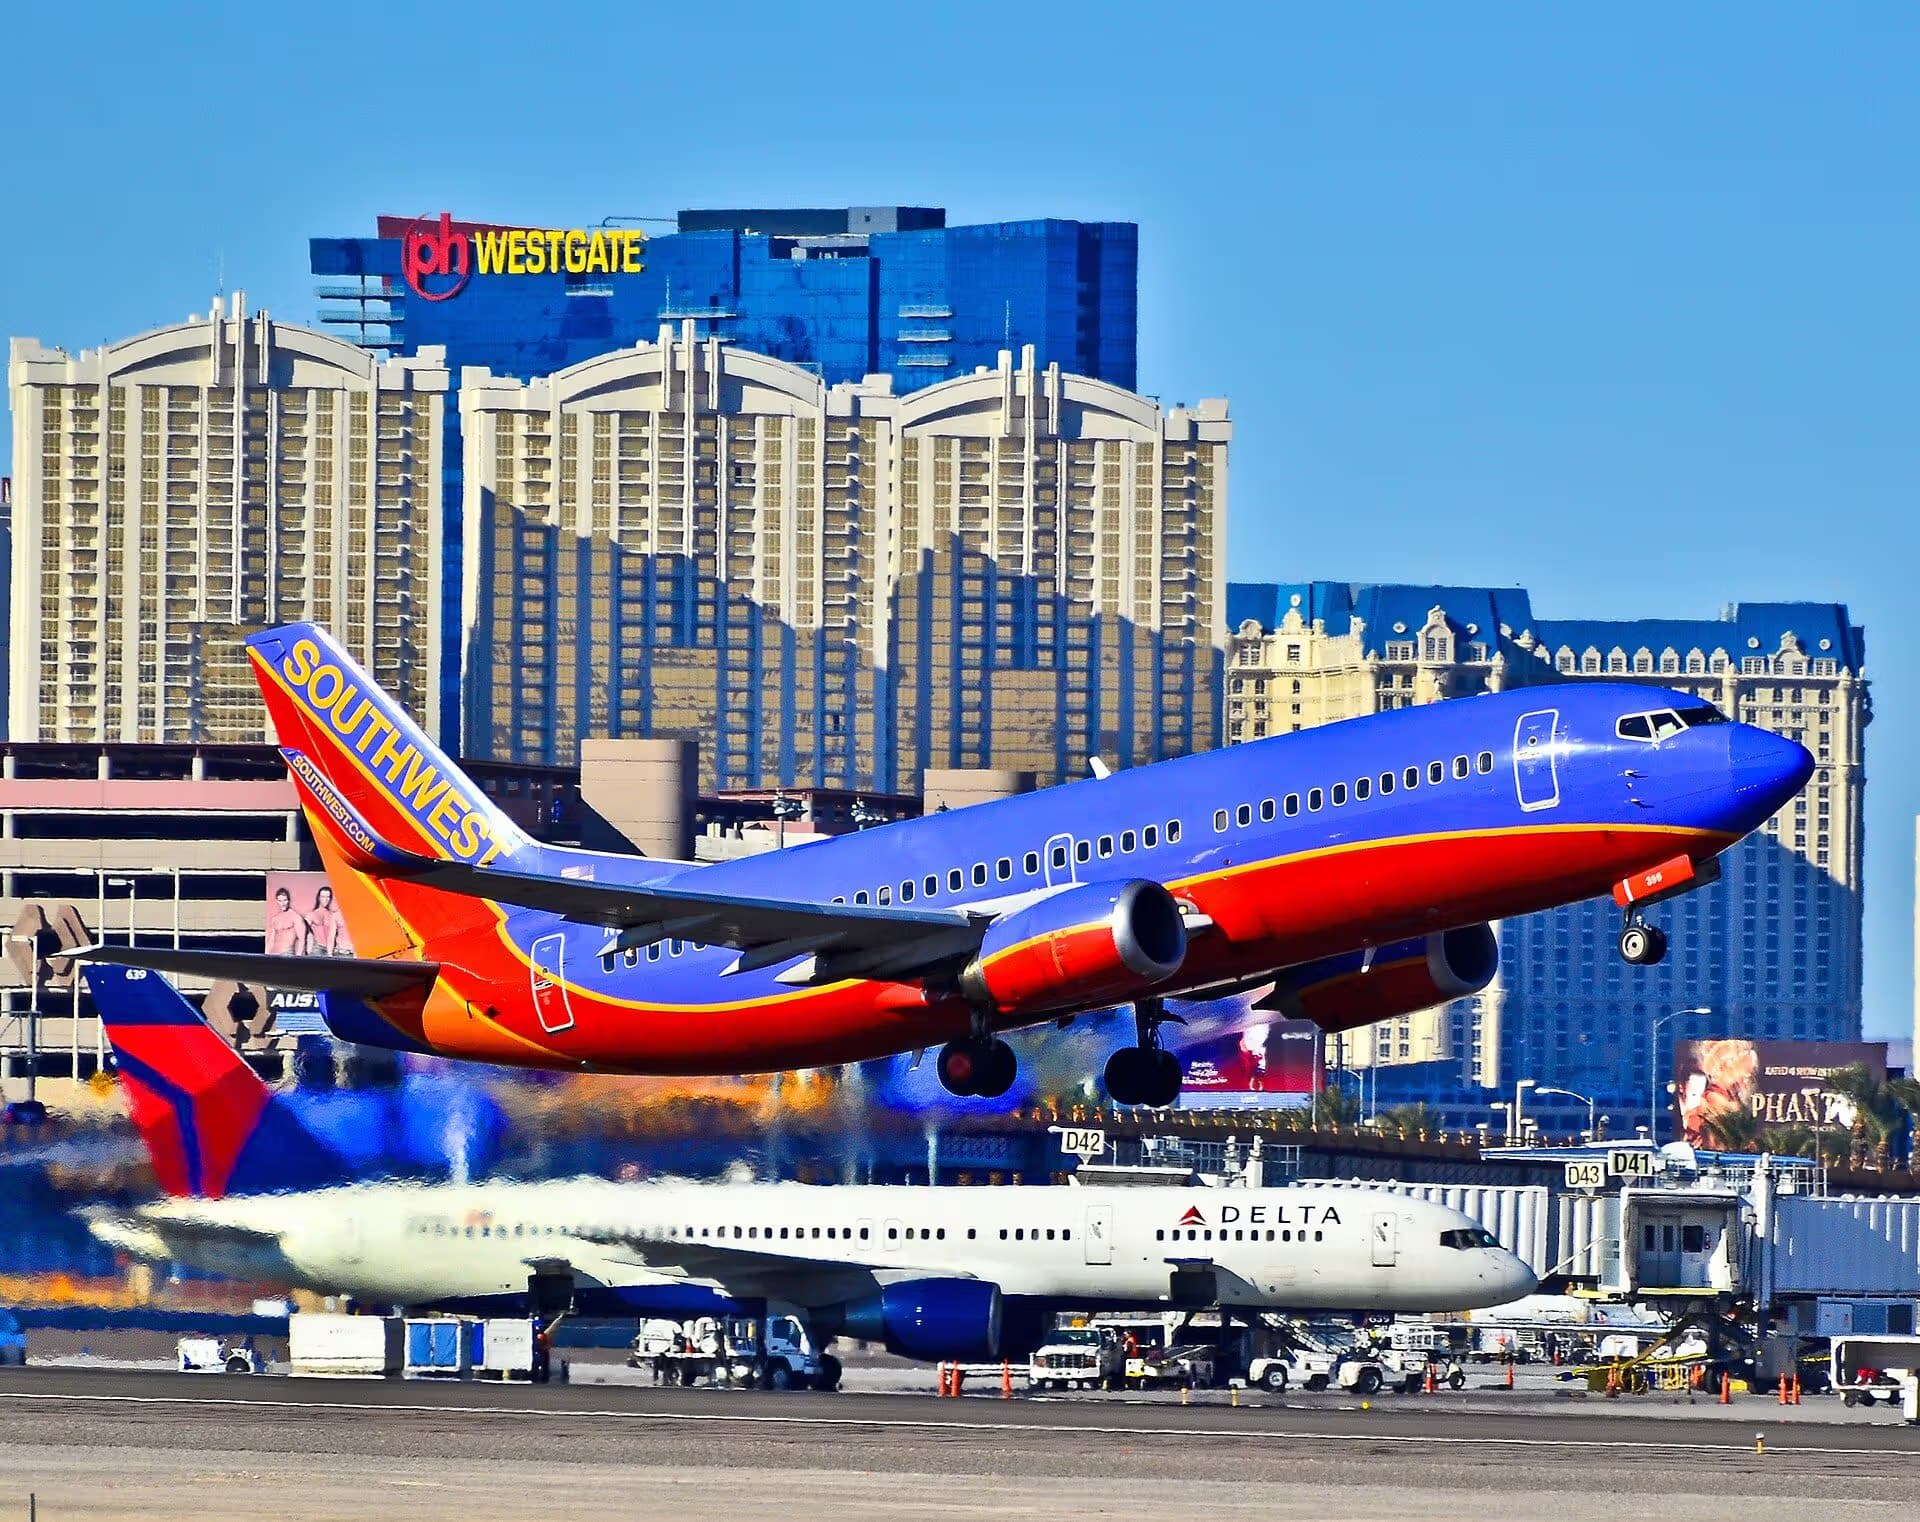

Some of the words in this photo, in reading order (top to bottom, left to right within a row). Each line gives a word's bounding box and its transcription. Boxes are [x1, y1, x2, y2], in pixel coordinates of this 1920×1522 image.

[475, 229, 642, 275] WESTGATE
[283, 638, 514, 868] SOUTHWEST
[293, 755, 376, 853] SOUTHWEST.COM
[125, 968, 147, 980] 639
[1751, 1088, 1857, 1127] PHANT
[1066, 1131, 1101, 1152] D42
[1568, 1165, 1600, 1185] D43
[1614, 1153, 1649, 1175] D41
[1221, 1205, 1342, 1225] DELTA
